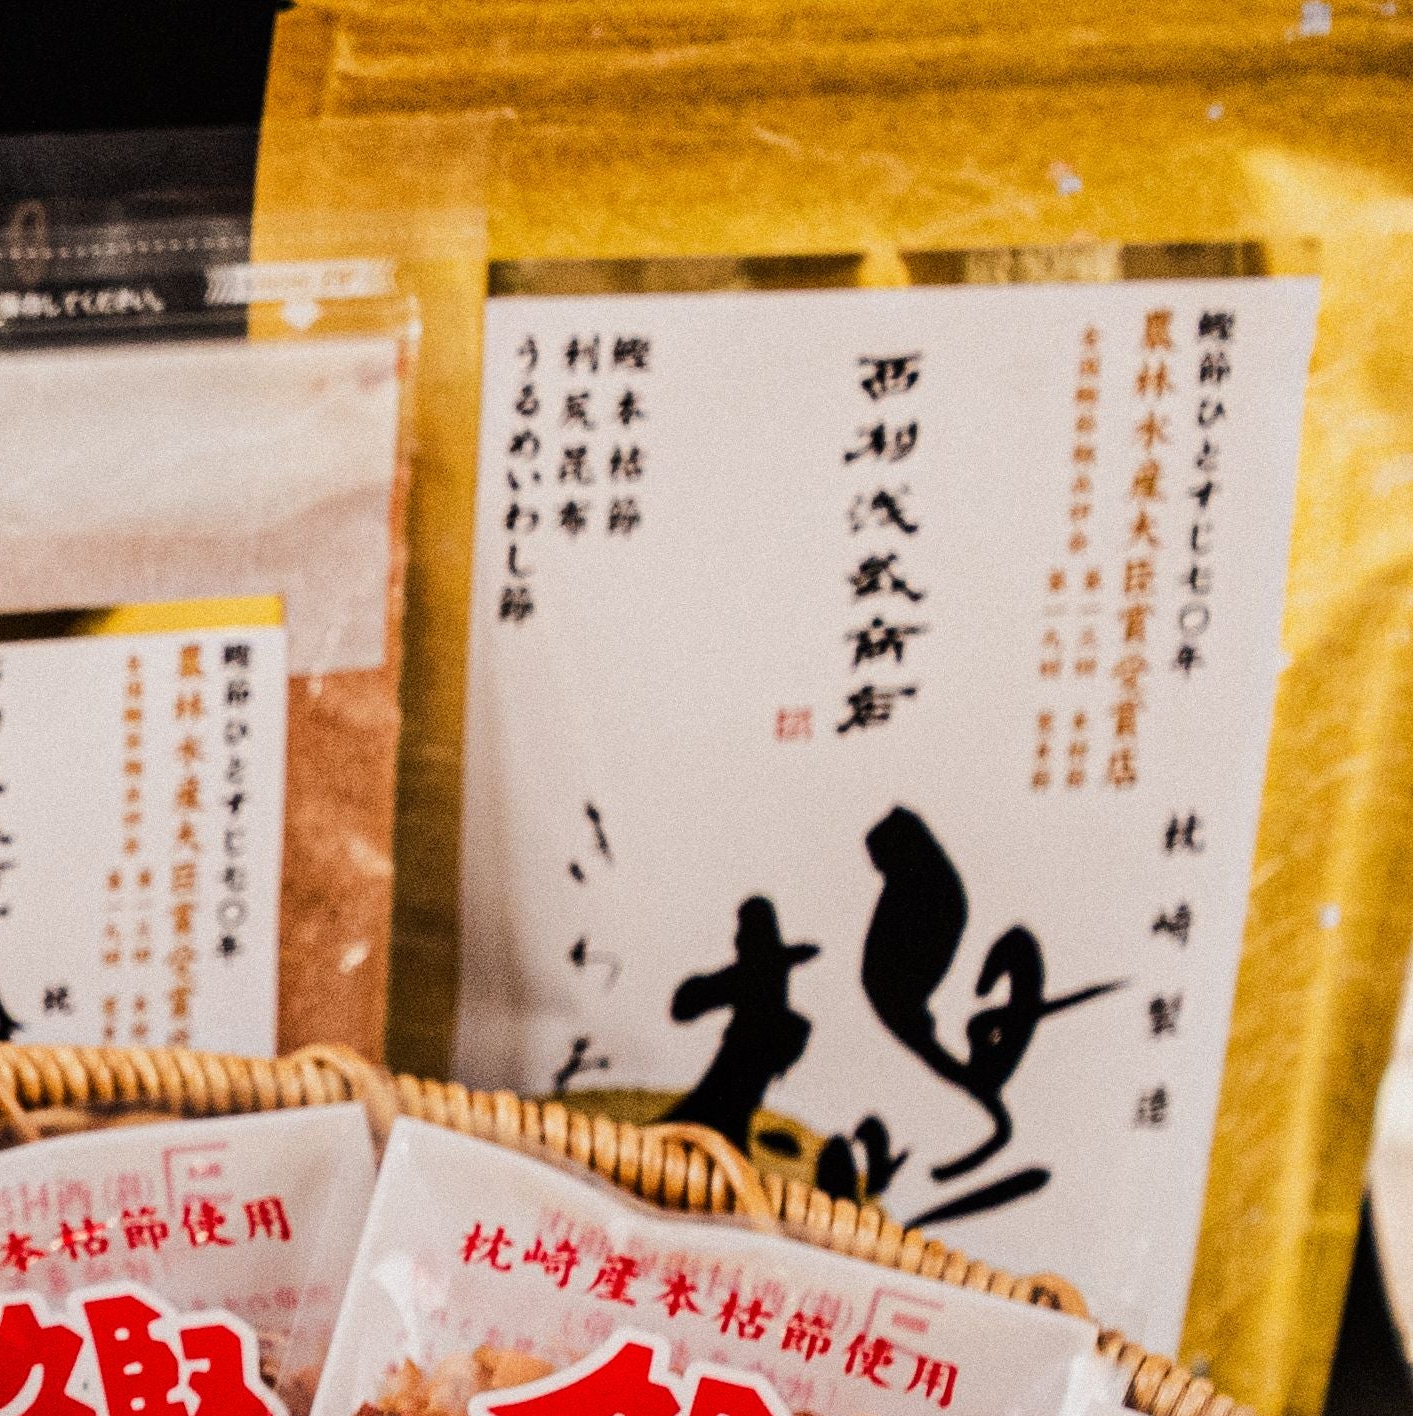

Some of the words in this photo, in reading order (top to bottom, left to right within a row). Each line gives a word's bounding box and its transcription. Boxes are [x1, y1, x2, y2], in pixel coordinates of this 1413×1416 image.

[460, 1222, 959, 1407] 枕崎産本枯節使用
